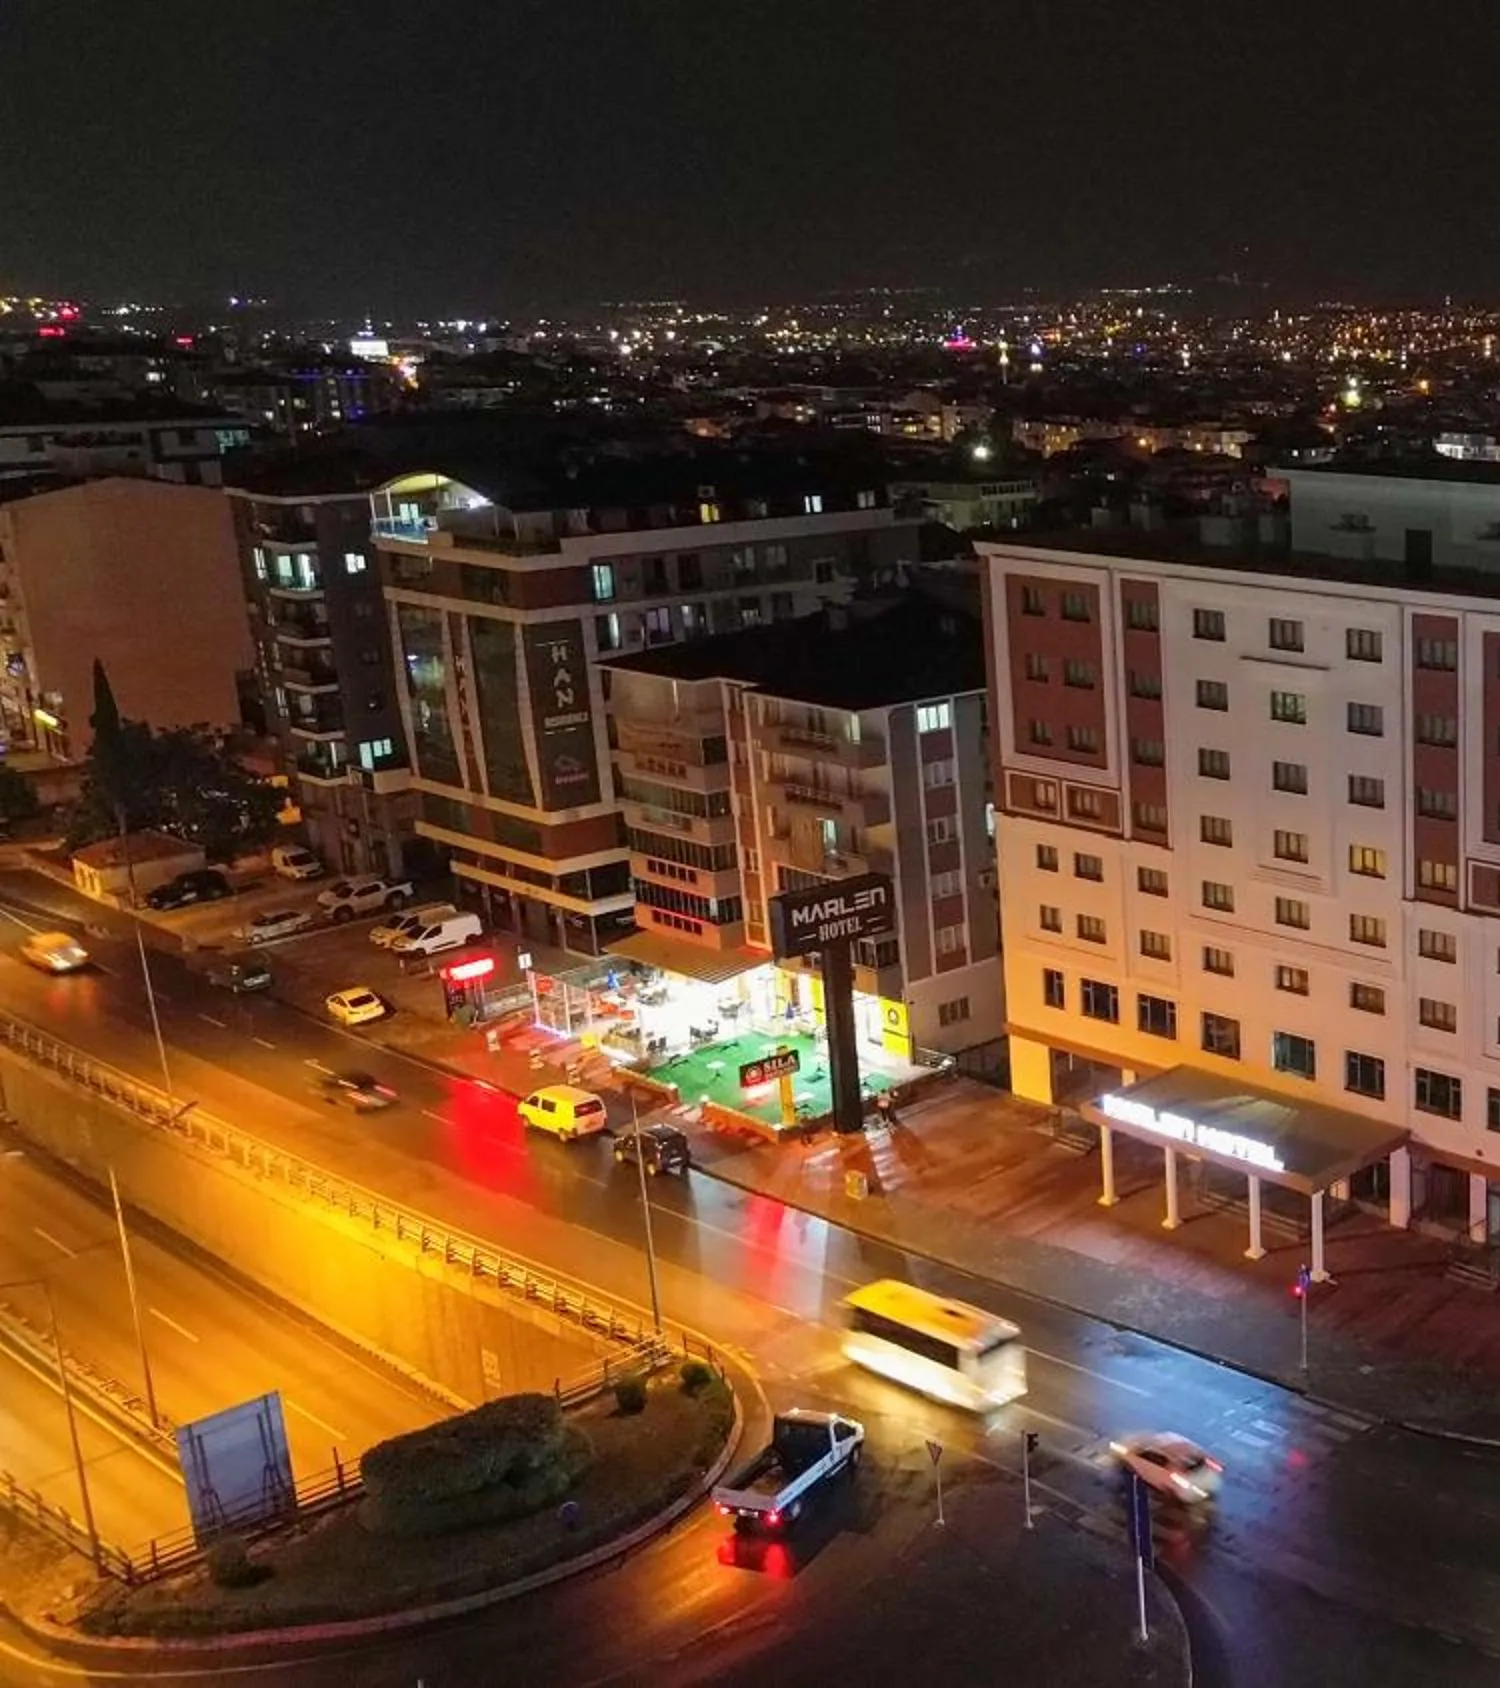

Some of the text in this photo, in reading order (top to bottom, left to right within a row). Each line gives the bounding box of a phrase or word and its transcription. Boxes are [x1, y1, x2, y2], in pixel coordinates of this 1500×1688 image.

[551, 645, 574, 708] HAN
[791, 887, 885, 927] MARLEN
[819, 916, 862, 941] HOTEL
